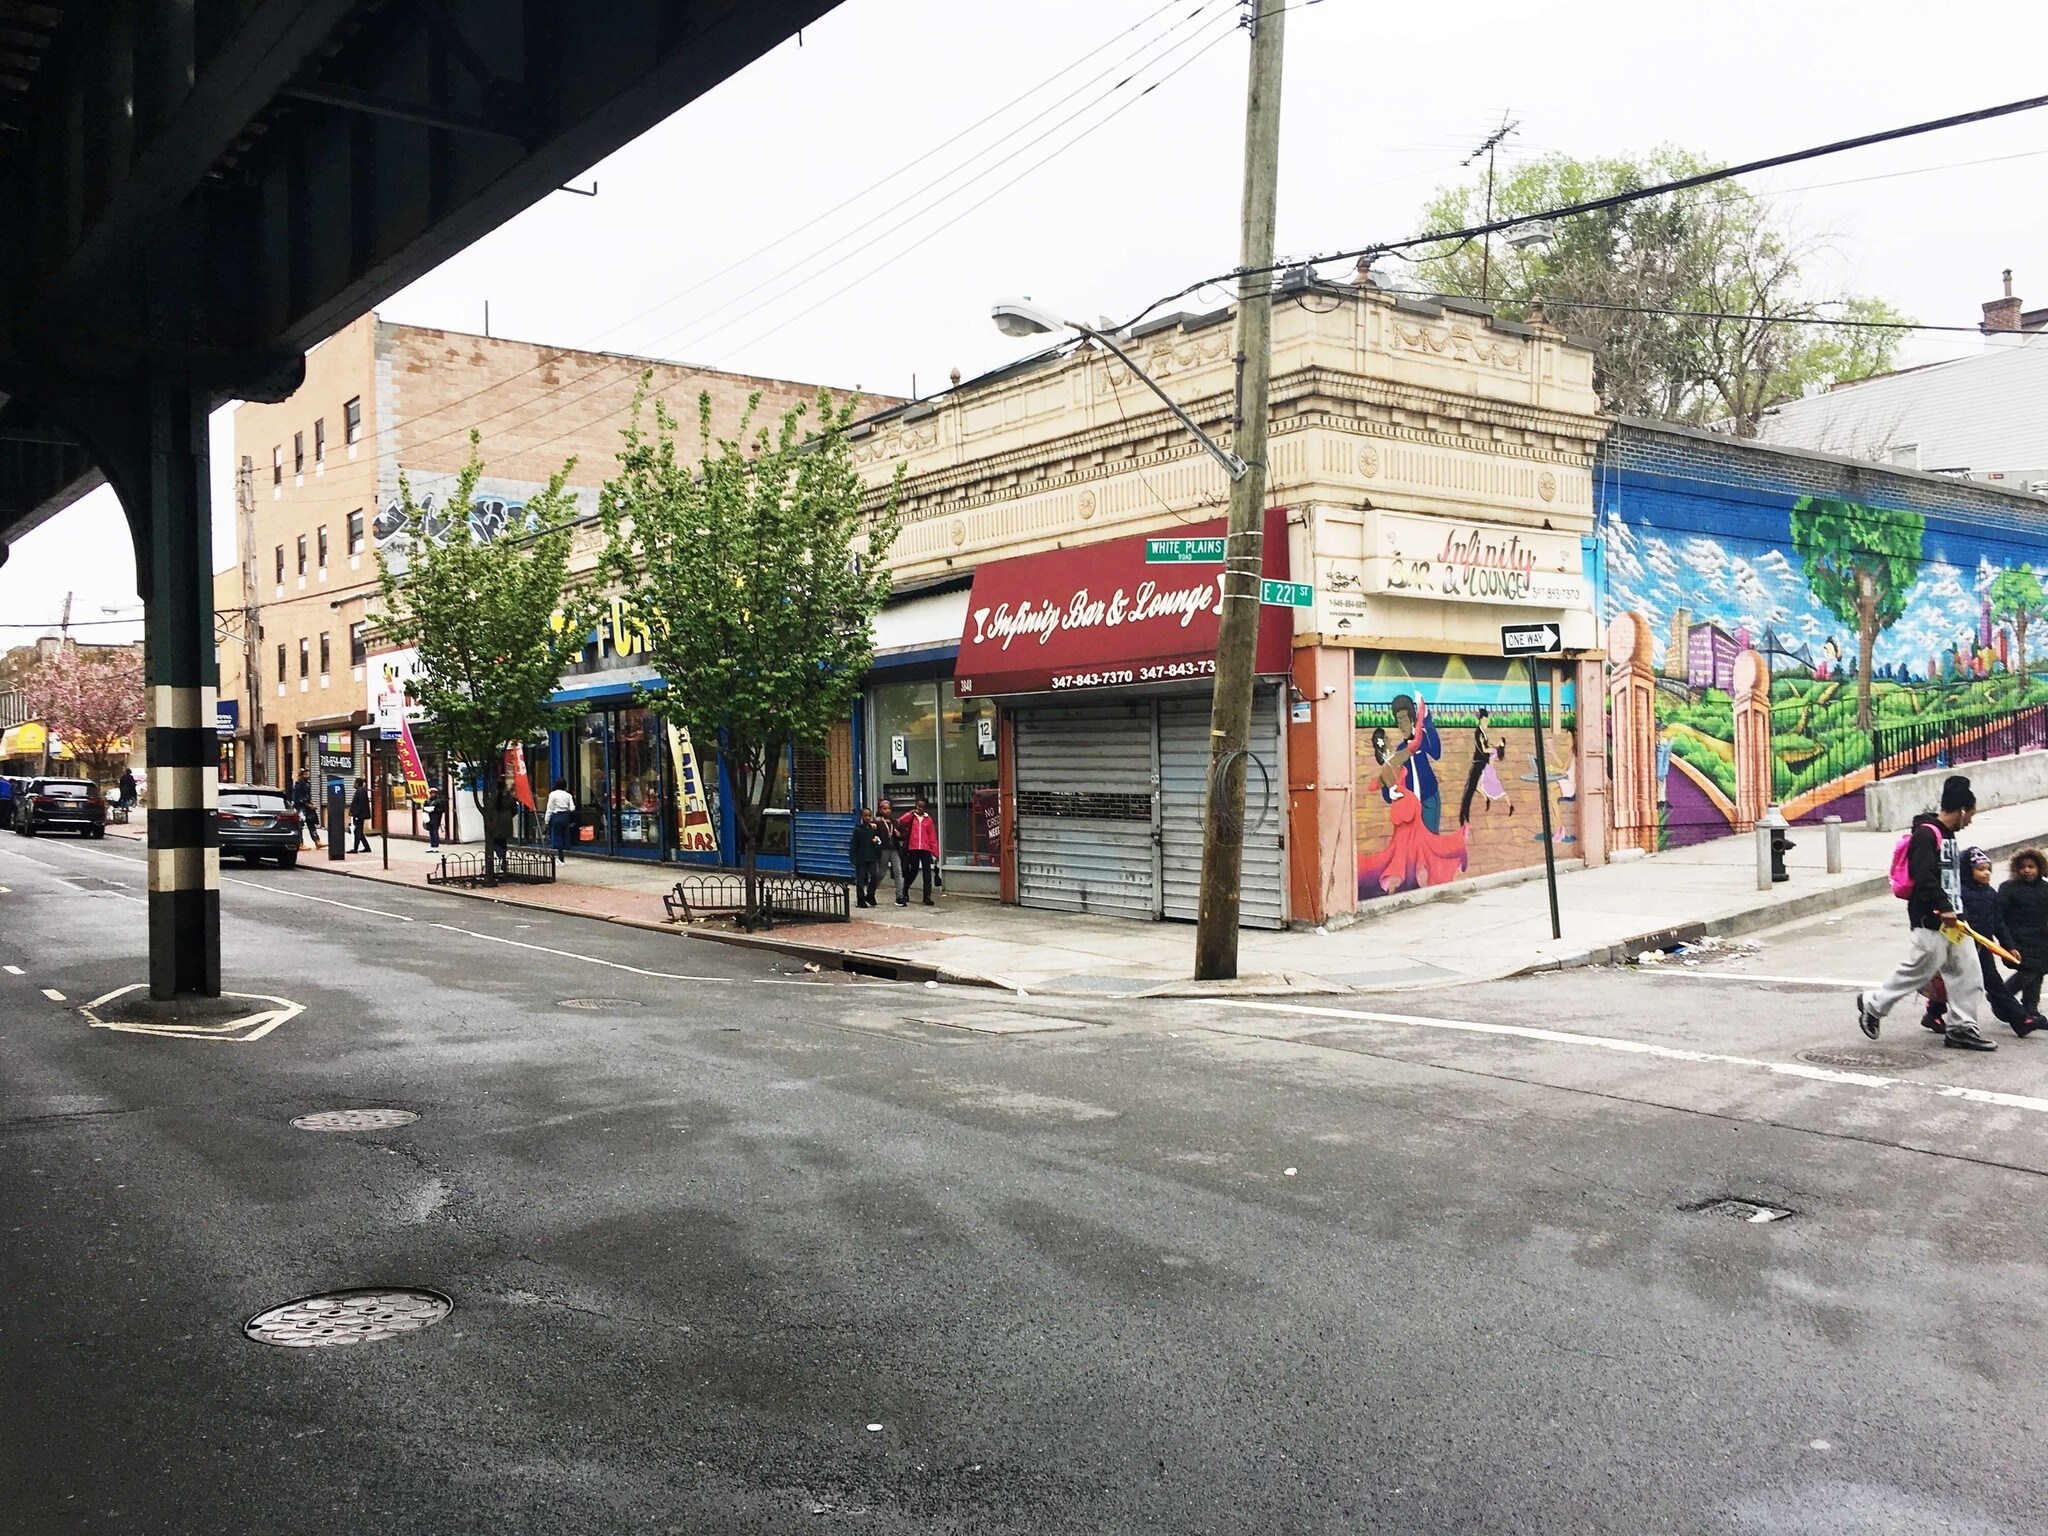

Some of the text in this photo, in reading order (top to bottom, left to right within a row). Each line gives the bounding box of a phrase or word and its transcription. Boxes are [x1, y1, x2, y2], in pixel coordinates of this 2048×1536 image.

[1151, 541, 1222, 554] WHITE PLAINS
[1437, 529, 1537, 591] Infinity
[1386, 559, 1434, 591] BAR
[1442, 565, 1460, 595] &
[1468, 567, 1526, 600] LOUNGE
[1264, 583, 1309, 604] E 221 ST
[987, 580, 1214, 651] Infinity Bar & Lounge
[1508, 633, 1544, 647] ONE WAY
[1051, 660, 1217, 689] 347-843-7370 347-843-73
[979, 722, 990, 736] 12
[893, 739, 903, 752] 18
[334, 785, 341, 794] P
[984, 807, 995, 818] NO
